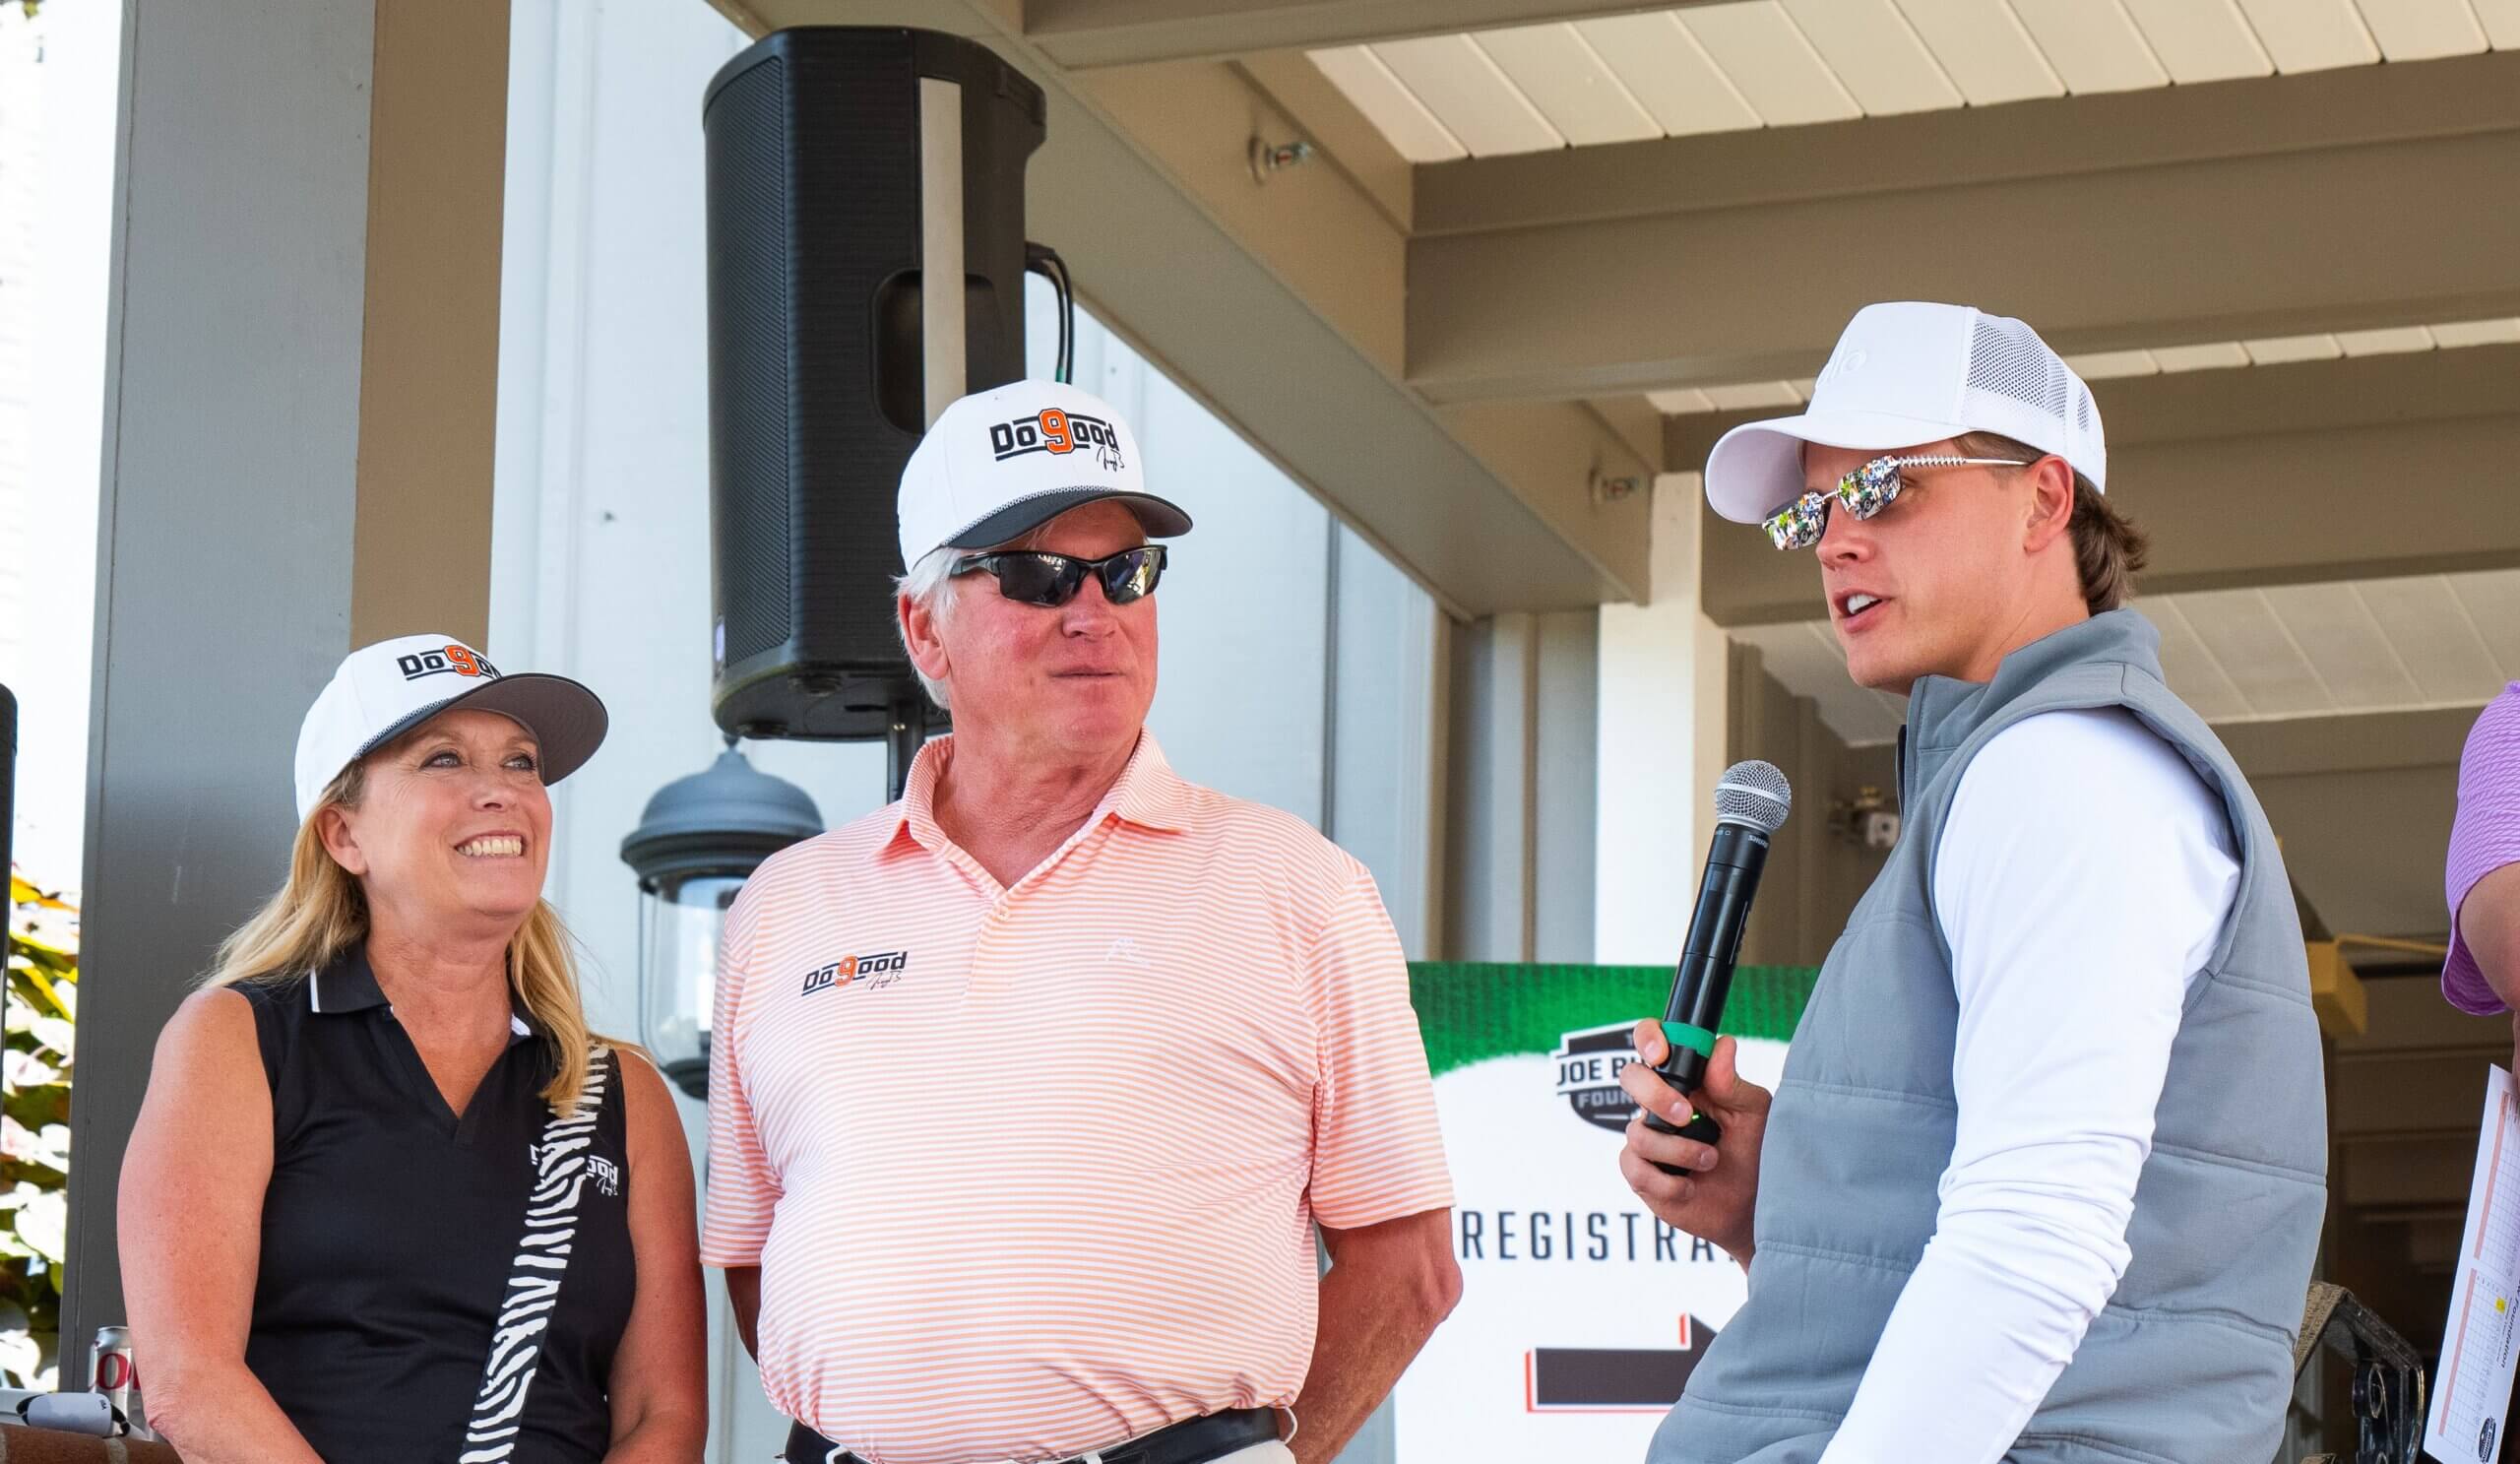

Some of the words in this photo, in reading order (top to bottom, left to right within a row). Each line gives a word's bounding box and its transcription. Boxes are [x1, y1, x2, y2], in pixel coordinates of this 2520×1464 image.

[1557, 1058, 1603, 1086] JOE
[1577, 1089, 1634, 1109] FOUN
[1462, 1210, 1734, 1262] REGISTRA
